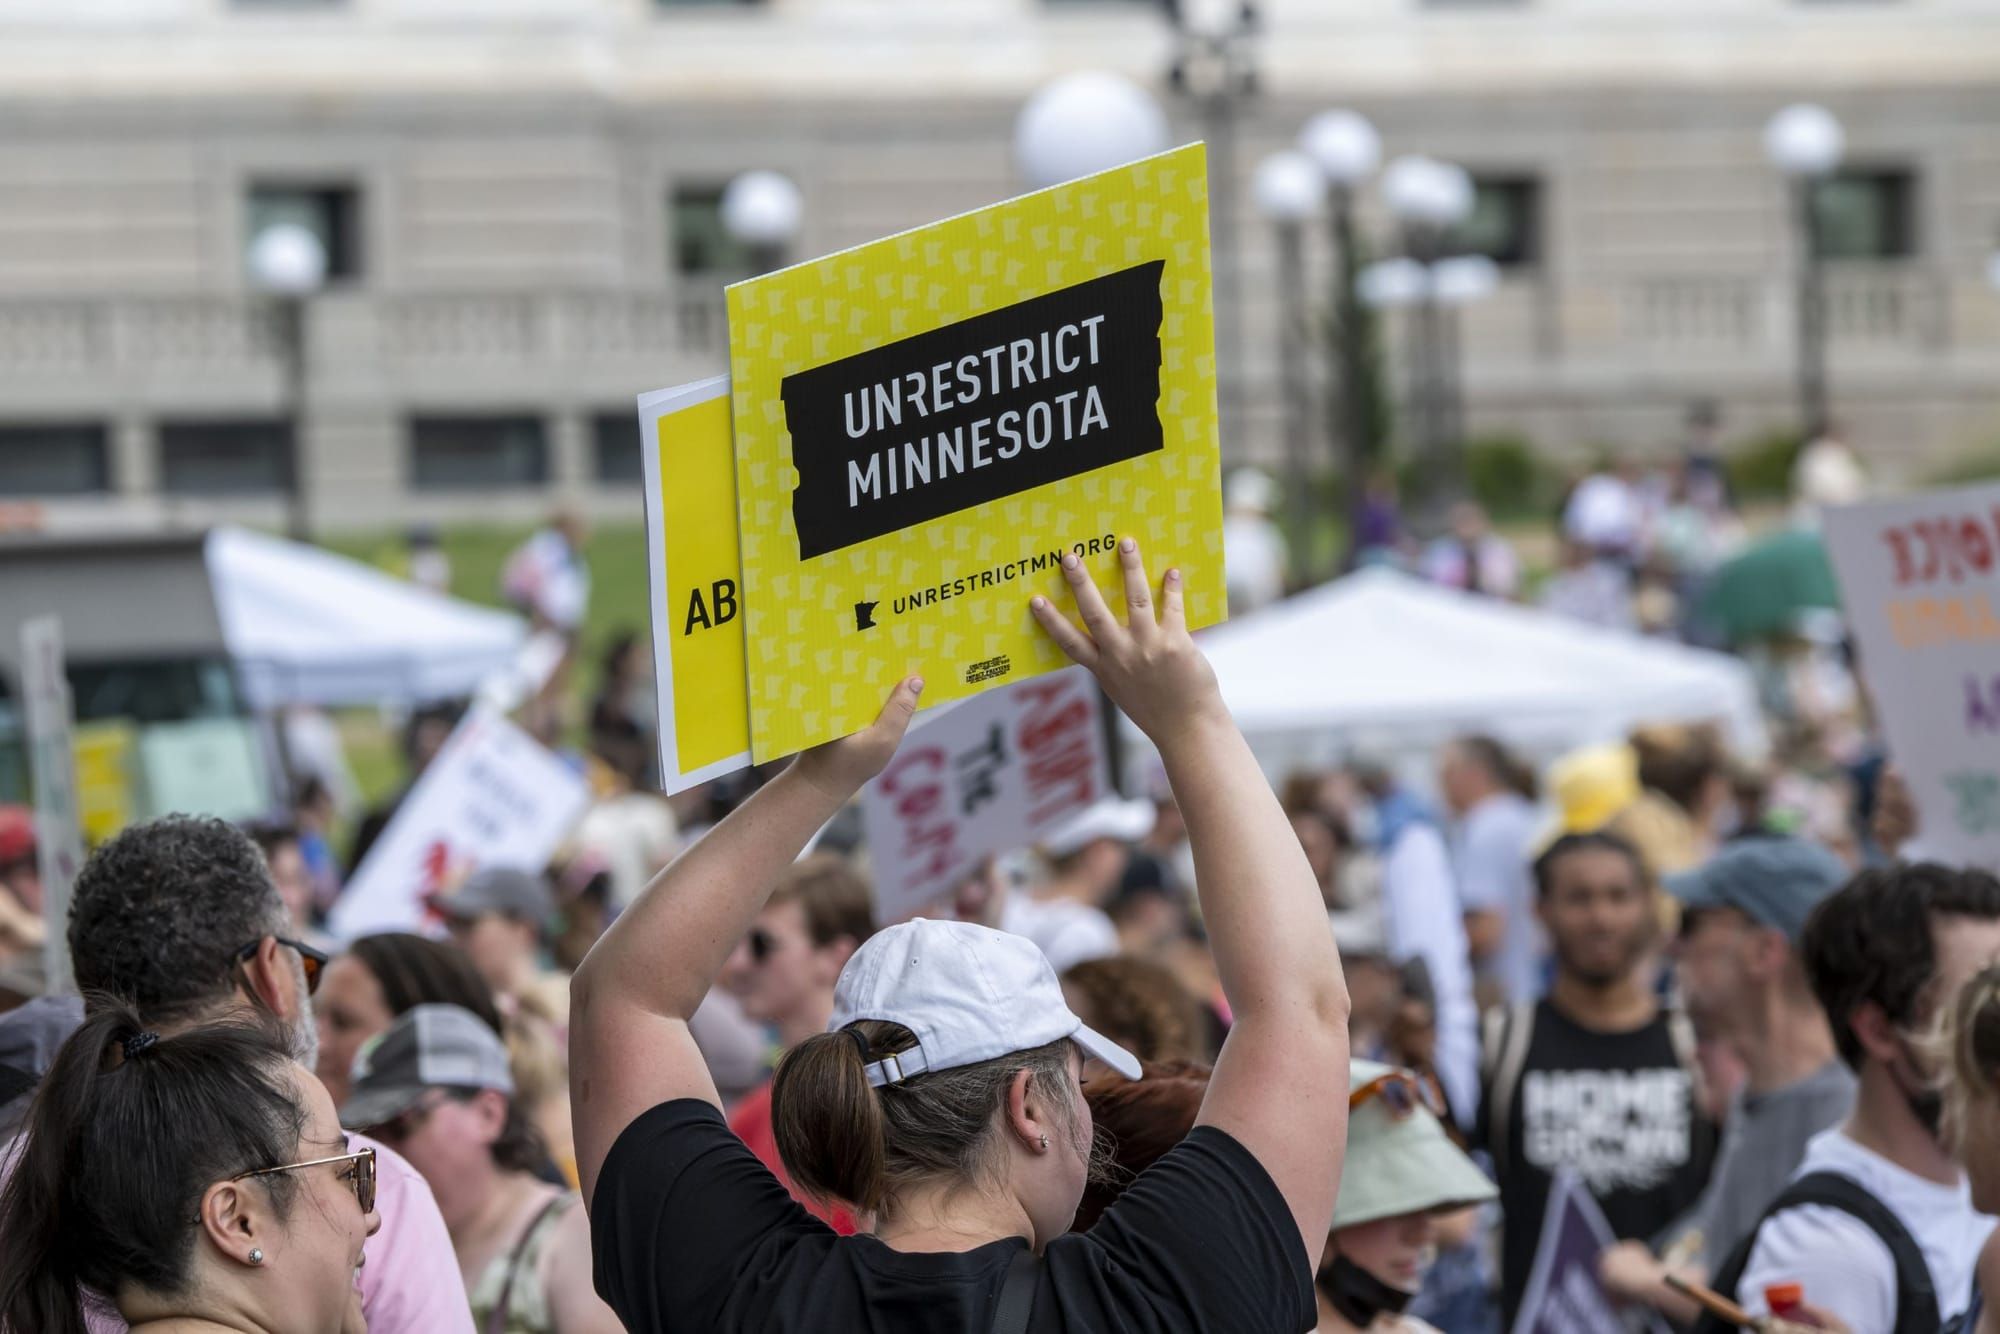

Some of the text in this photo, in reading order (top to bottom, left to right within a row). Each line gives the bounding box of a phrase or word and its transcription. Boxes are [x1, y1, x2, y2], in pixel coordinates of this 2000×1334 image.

[844, 314, 1105, 439] UNRESTRICT
[848, 384, 1109, 508] MINNESOTA
[893, 533, 1116, 615] UNRESTRICTMNORG
[1522, 1067, 1692, 1130] HOME
